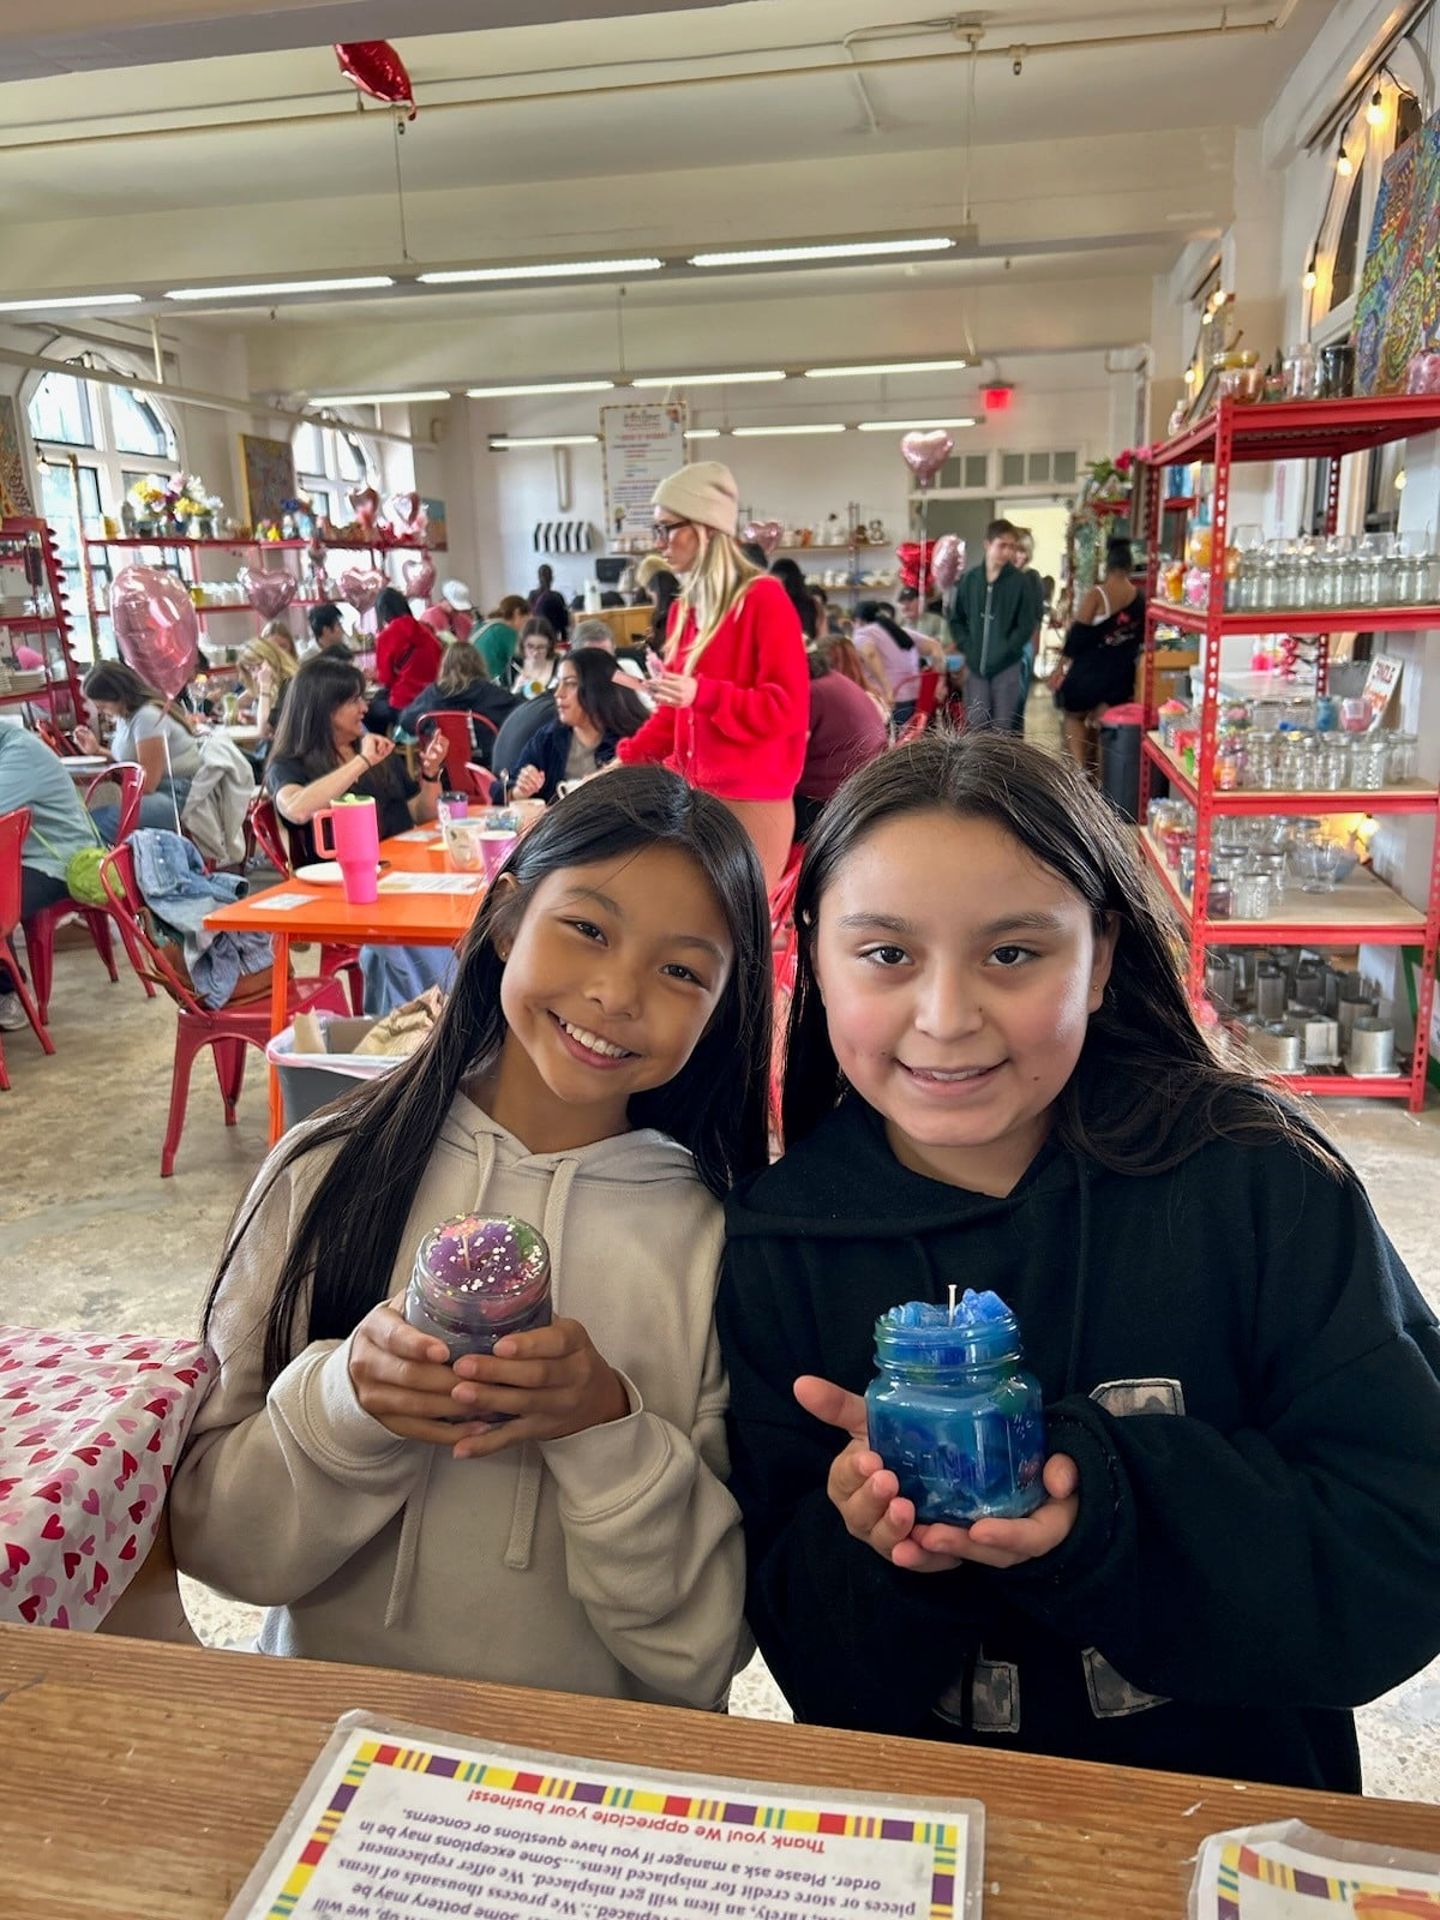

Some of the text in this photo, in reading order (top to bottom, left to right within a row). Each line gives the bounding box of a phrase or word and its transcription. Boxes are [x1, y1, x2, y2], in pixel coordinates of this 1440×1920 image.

[360, 1821, 374, 1834] in
[468, 1789, 824, 1854] Thank you! We appreciate your business!
[378, 1824, 396, 1838] be
[398, 1826, 431, 1843] may
[358, 1841, 454, 1868] replacement
[402, 1809, 881, 1893] order. Please ask a manager if you have questions or concerns.
[436, 1836, 516, 1858] exceptions
[339, 1858, 380, 1877] items
[382, 1866, 400, 1880] of
[457, 1860, 496, 1878] offer
[404, 1871, 483, 1897] thousands
[498, 1868, 523, 1884] We
[626, 1868, 707, 1890] misplaced
[352, 1883, 373, 1899] be
[532, 1874, 615, 1897] misplaced.
[620, 1887, 645, 1900] get
[712, 1881, 737, 1896] for
[741, 1885, 790, 1902] credit
[374, 1887, 409, 1904] may
[488, 1888, 548, 1908] process
[648, 1894, 677, 1908] will
[795, 1892, 836, 1906] store
[843, 1898, 860, 1909] or
[313, 1898, 342, 1912] will
[346, 1905, 370, 1918] we
[409, 1893, 472, 1917] pottery
[550, 1899, 576, 1915] We
[684, 1898, 720, 1916] item
[726, 1904, 746, 1915] an
[751, 1905, 807, 1920] rarely,
[866, 1900, 916, 1918] pieces
[376, 1908, 399, 1920] up,
[474, 1907, 519, 1920] Some
